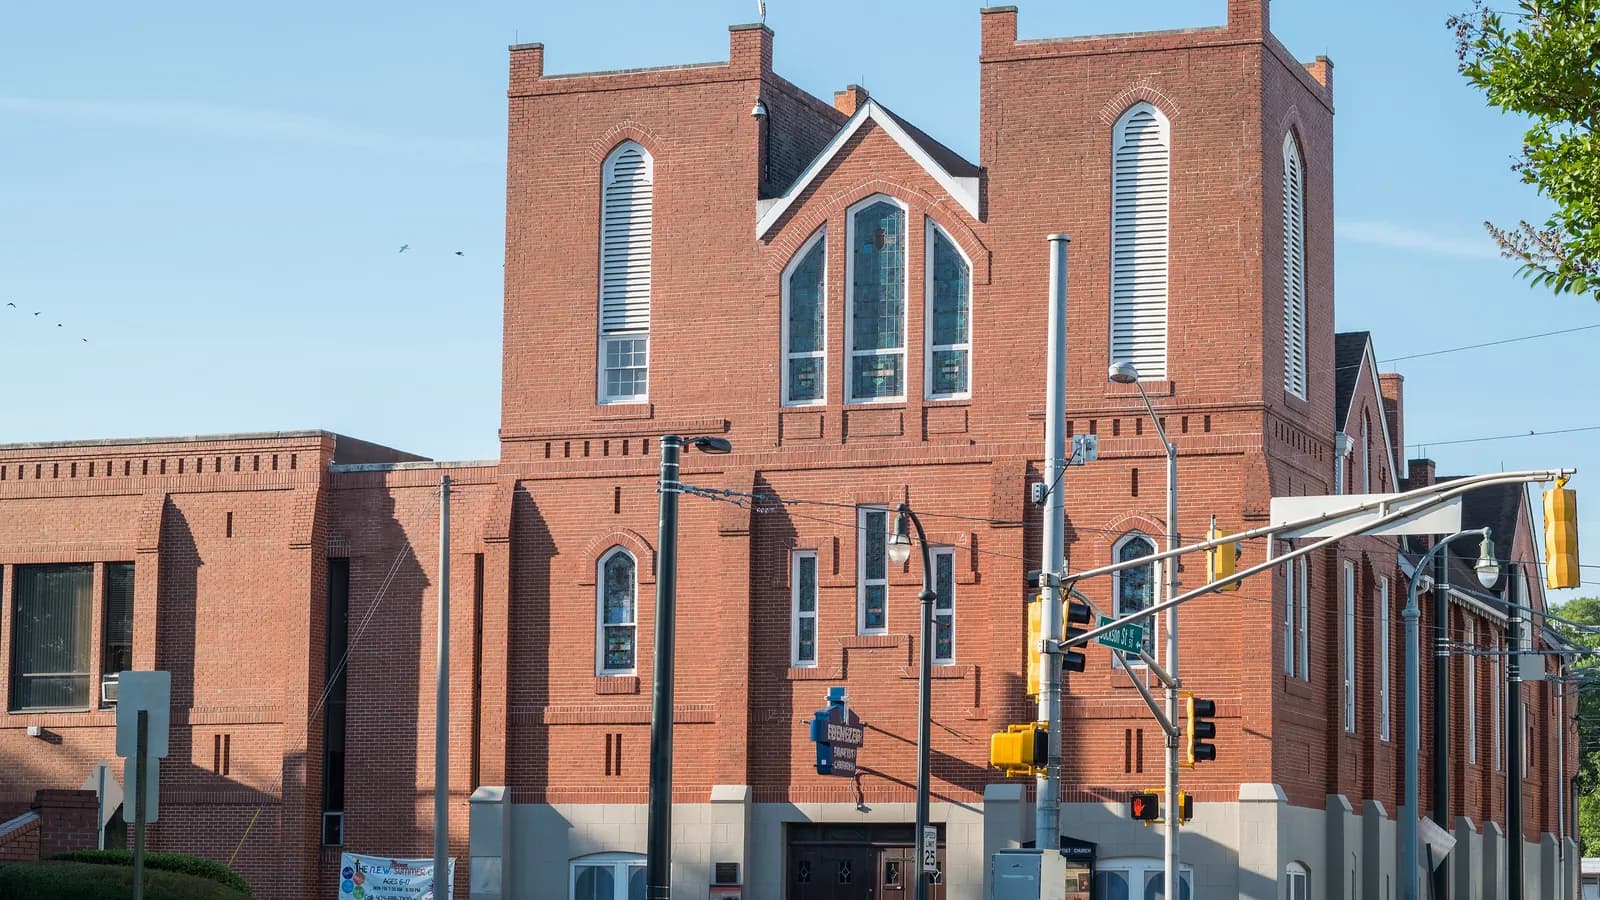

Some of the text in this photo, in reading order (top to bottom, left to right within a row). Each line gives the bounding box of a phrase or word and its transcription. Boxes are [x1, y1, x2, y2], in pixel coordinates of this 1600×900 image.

[1121, 628, 1128, 646] St
[827, 724, 863, 745] EBENEZER
[833, 746, 856, 759] BAPTIST
[833, 760, 856, 772] CHURCH
[925, 849, 936, 866] 25
[383, 877, 398, 886] AGES
